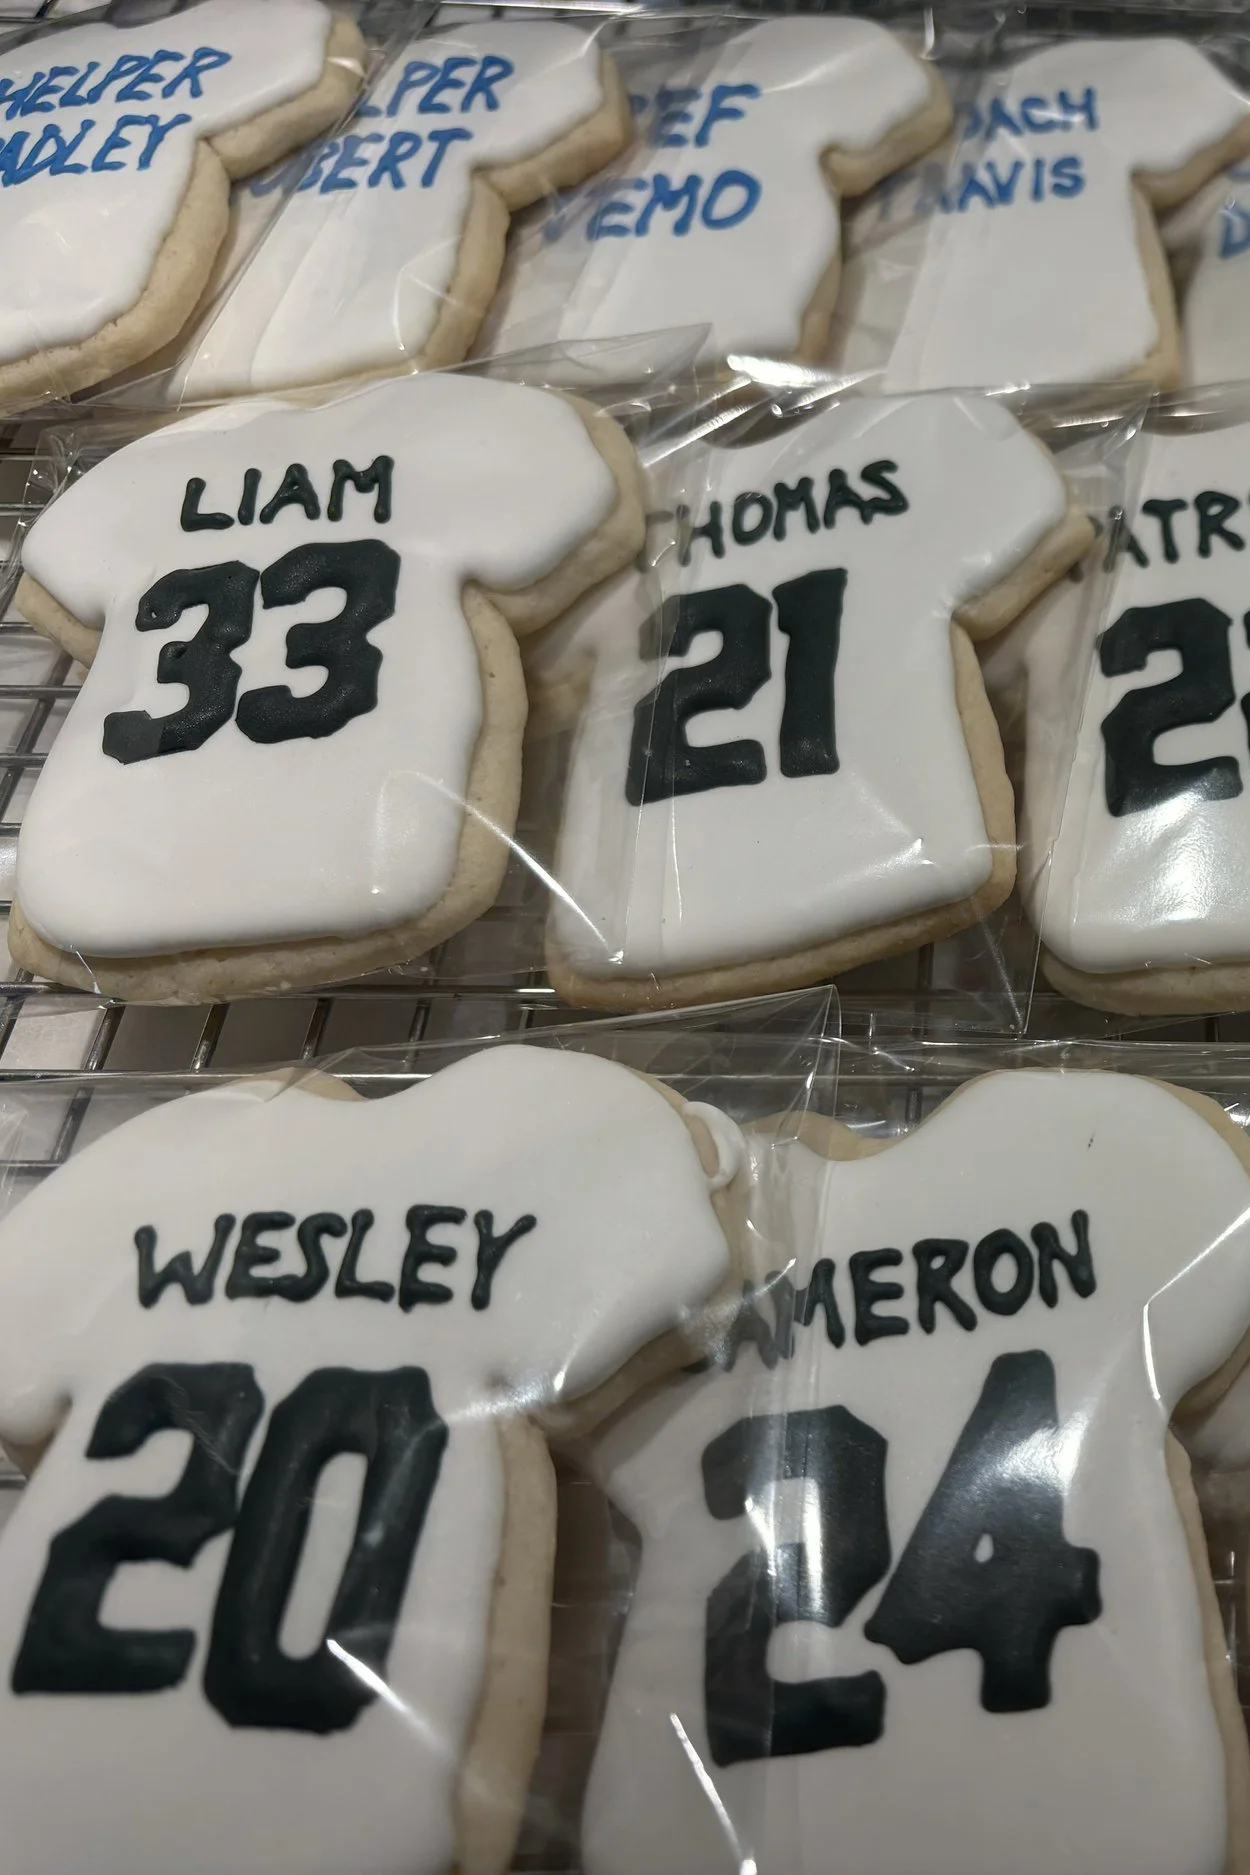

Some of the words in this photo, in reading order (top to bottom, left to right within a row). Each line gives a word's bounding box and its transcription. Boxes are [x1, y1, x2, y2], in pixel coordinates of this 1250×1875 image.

[629, 83, 761, 148] EF
[181, 455, 394, 532] LIAM
[102, 539, 401, 766] 33
[626, 568, 849, 806] 21
[133, 1204, 537, 1312] WESLEY
[682, 1209, 1097, 1374] AMERON
[11, 1362, 449, 1734] 20
[702, 1350, 1102, 1767] 24
